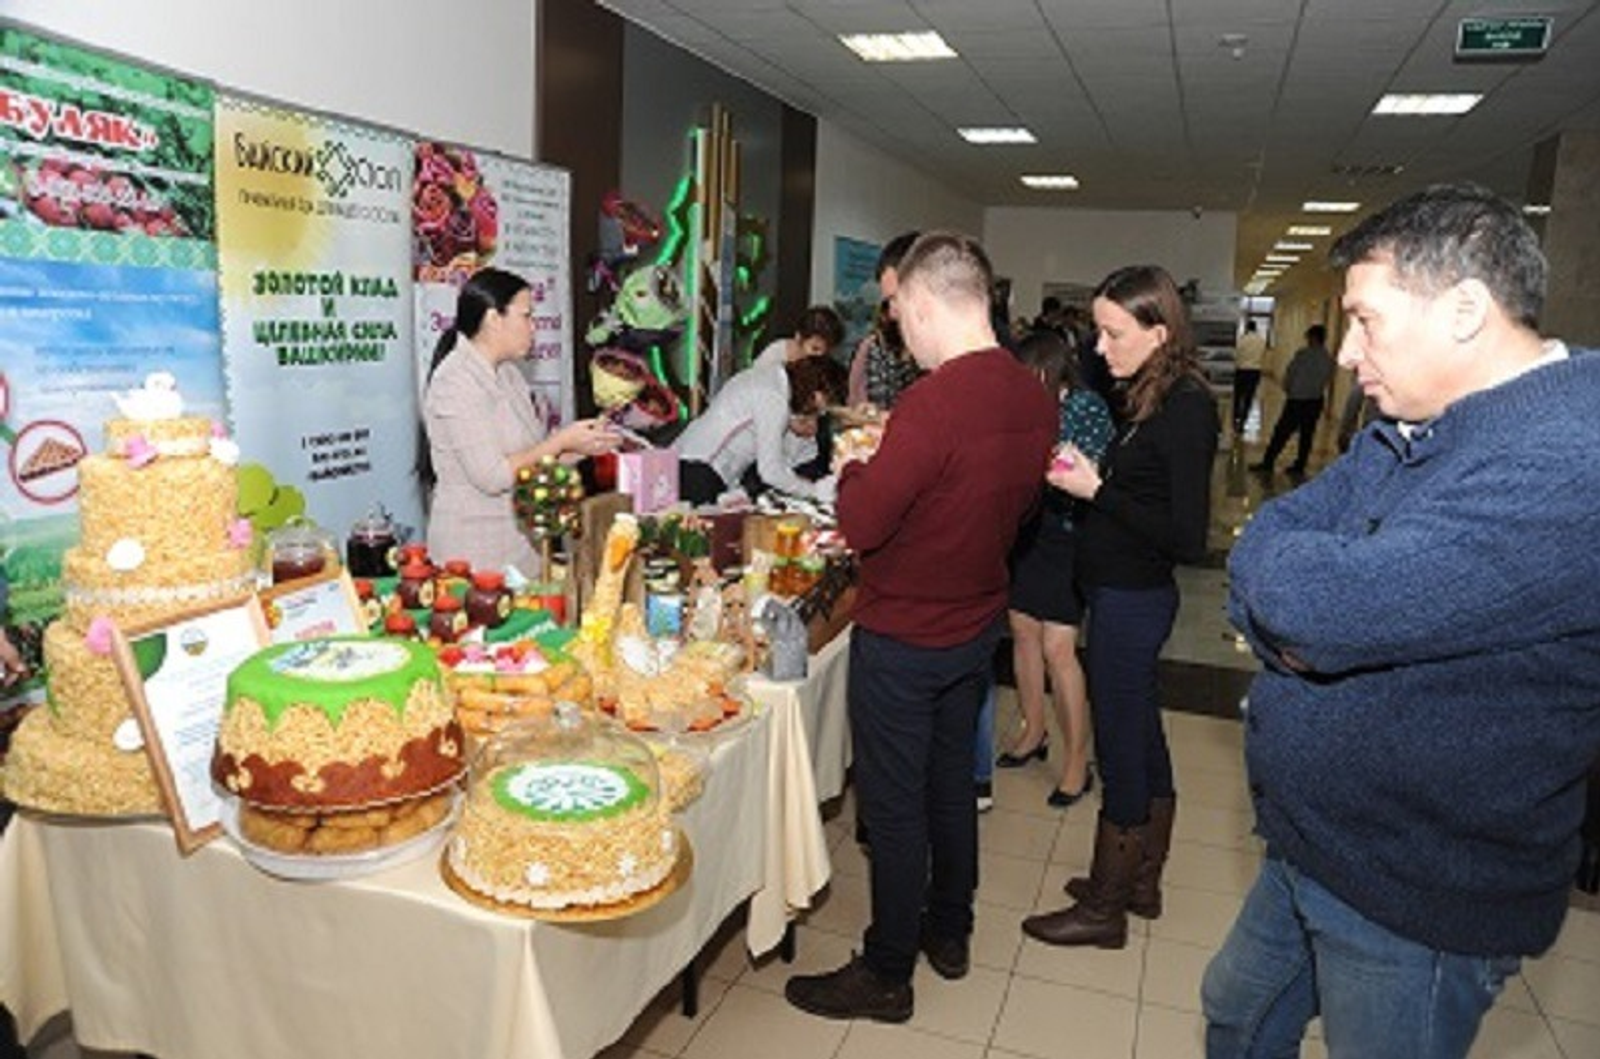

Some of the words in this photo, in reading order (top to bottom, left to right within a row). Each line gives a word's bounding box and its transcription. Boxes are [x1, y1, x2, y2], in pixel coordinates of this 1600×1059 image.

[253, 270, 344, 296] ЗОЛОТОЙ
[351, 276, 398, 298] КЛАД
[321, 297, 337, 317] И
[252, 320, 347, 346] ЦЕЛЕБНАЯ
[352, 321, 398, 340] СИЛА
